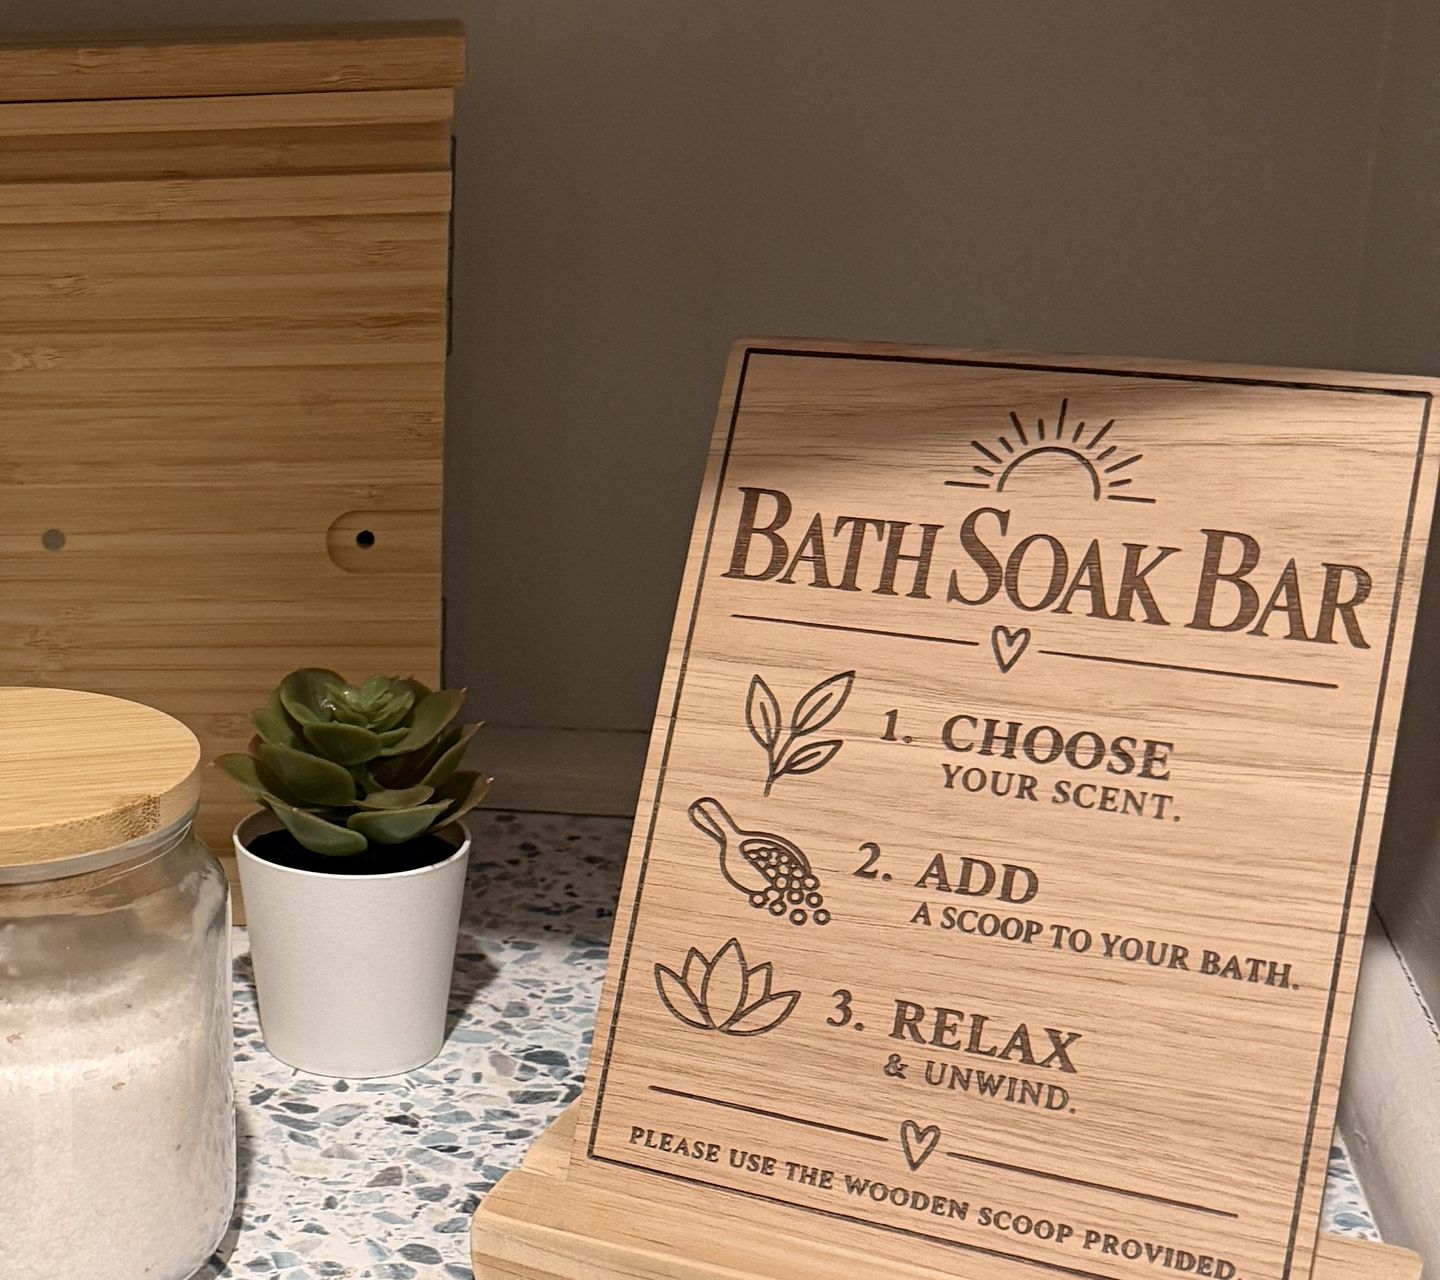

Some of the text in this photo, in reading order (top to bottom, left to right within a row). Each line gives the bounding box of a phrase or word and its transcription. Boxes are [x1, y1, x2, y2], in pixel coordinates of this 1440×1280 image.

[721, 486, 1373, 650] BATH SOAK BAR
[880, 709, 1173, 781] 1. CHOOSE
[941, 763, 1181, 823] YOUR SCENT.
[853, 842, 1038, 905] 2. ADD
[910, 902, 1299, 991] A SCOOP TO YOUR BATH.
[827, 990, 1083, 1075] 3. RELAX
[883, 1054, 1076, 1114] & UNWIND.
[629, 1126, 721, 1164] PLEASE
[729, 1150, 777, 1178] USE
[785, 1159, 833, 1192] THE
[845, 1174, 969, 1222] WOODEN
[977, 1206, 1073, 1245] SCOOP
